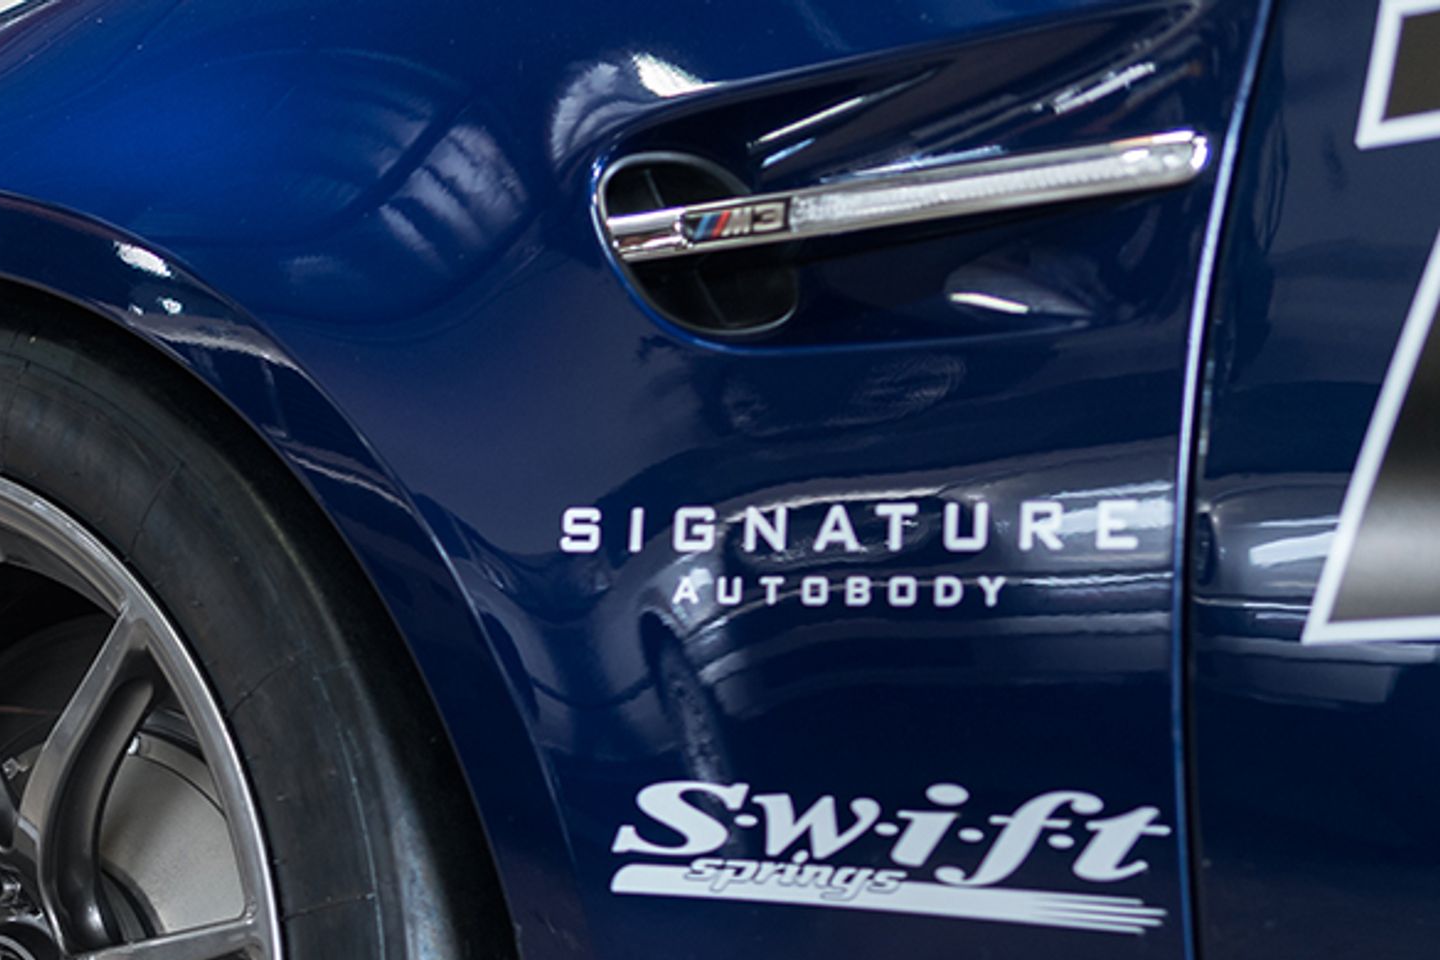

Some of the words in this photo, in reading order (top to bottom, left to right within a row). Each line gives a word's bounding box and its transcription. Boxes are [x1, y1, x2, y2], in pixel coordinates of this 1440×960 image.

[561, 500, 1140, 553] SIGNATURE
[671, 575, 1007, 606] AUTOBODY
[682, 855, 908, 902] springs
